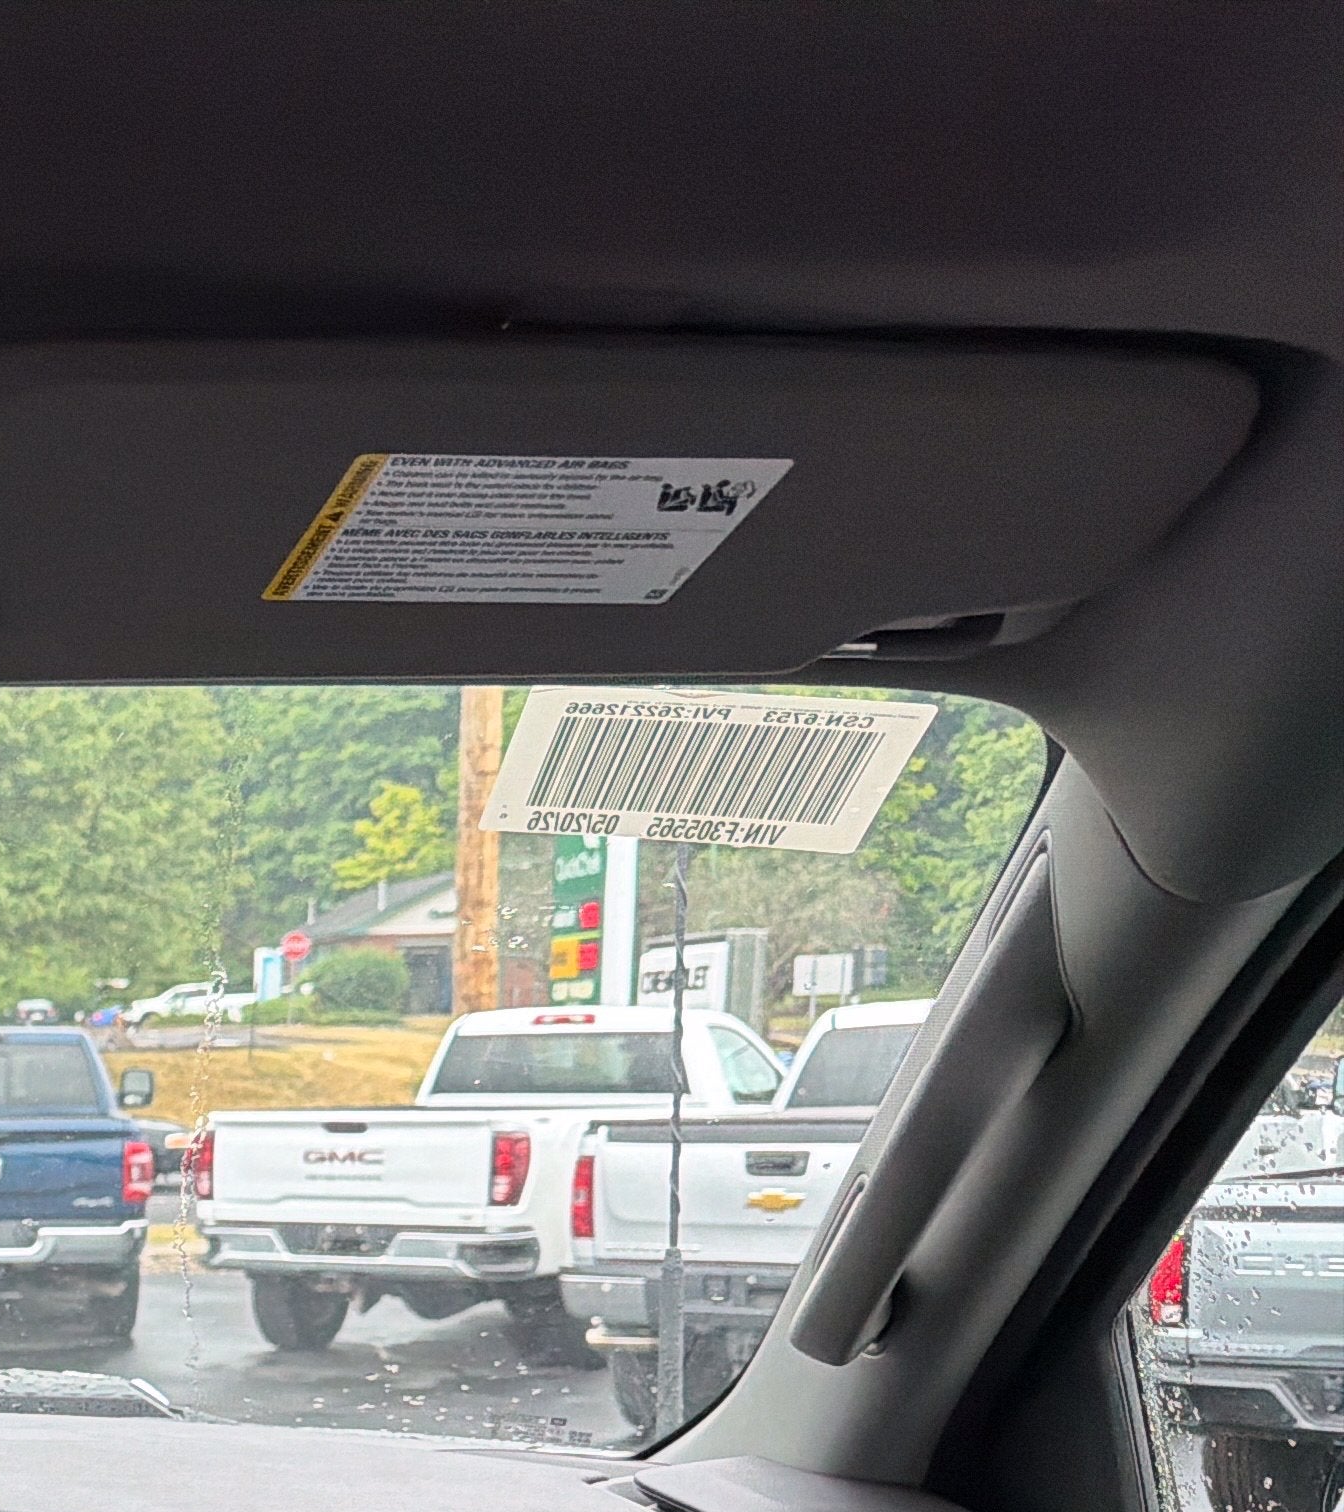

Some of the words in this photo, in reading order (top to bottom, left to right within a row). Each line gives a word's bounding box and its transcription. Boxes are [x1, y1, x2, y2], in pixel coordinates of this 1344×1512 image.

[390, 457, 432, 467] EVEN
[434, 458, 473, 468] WITH
[474, 459, 556, 469] ADVANCED
[558, 460, 586, 470] AIR
[587, 460, 630, 470] BAGS
[423, 529, 450, 539] DES
[452, 529, 489, 540] SACS
[302, 1148, 385, 1164] GMC
